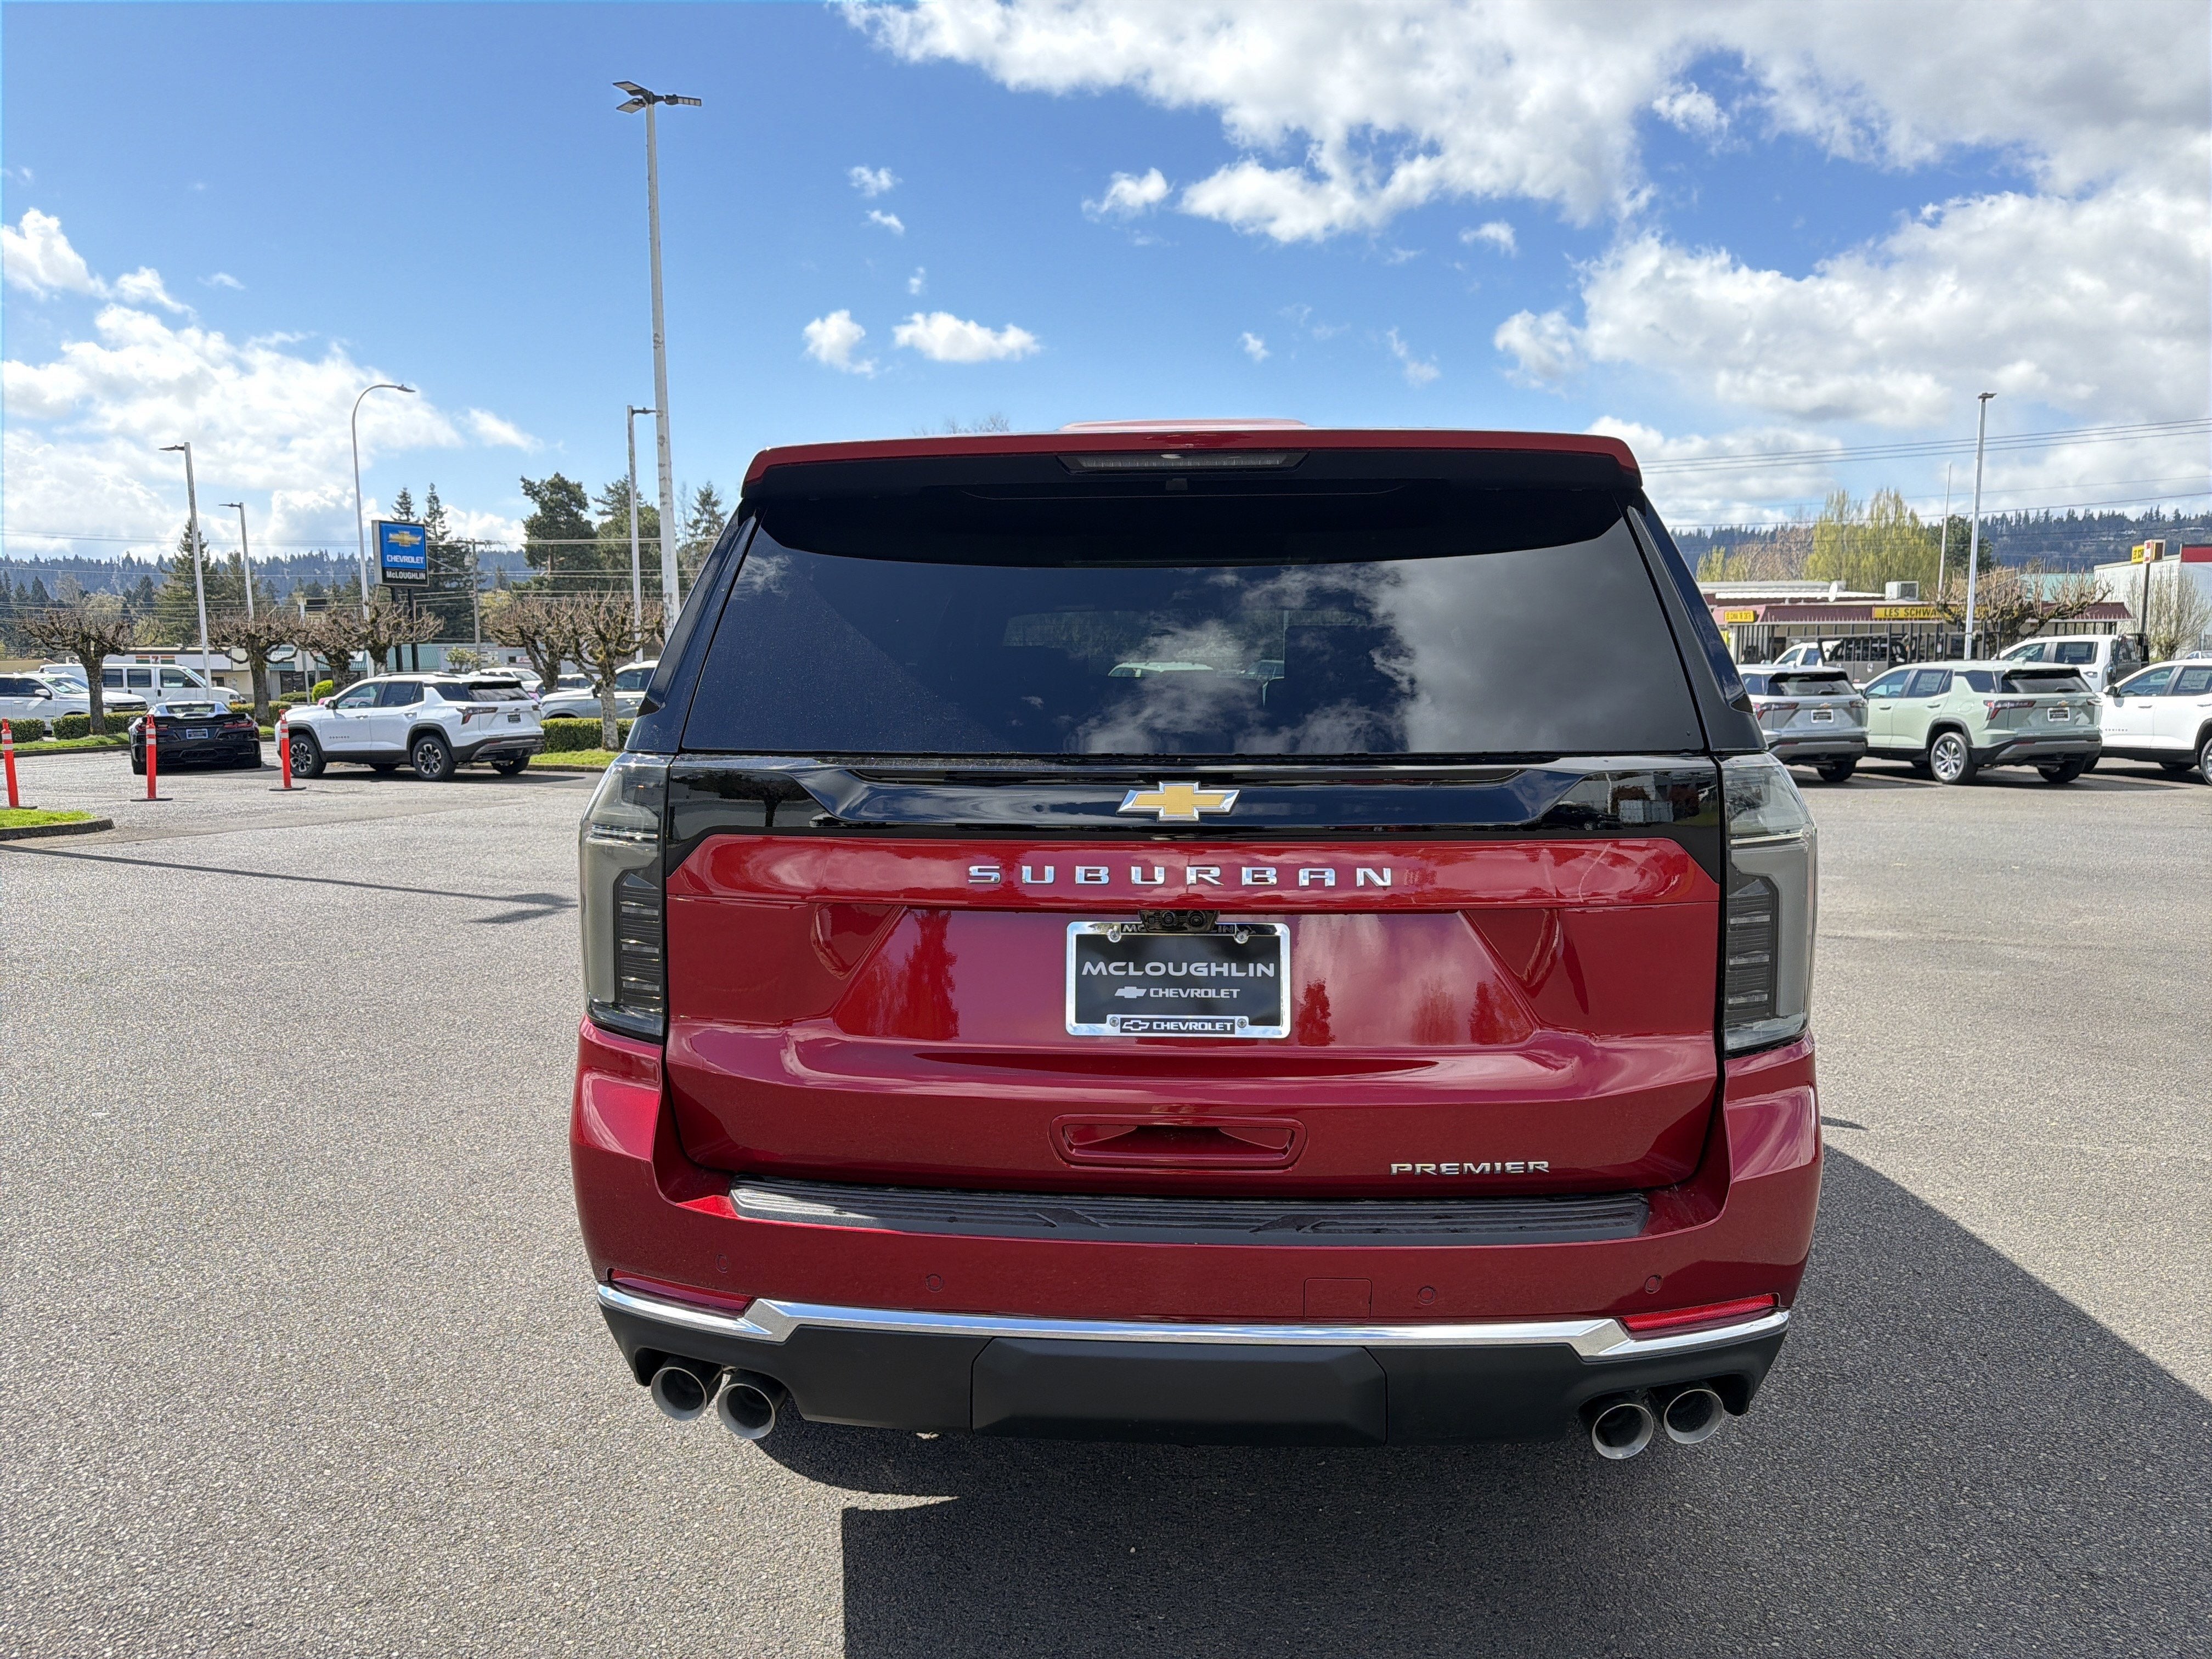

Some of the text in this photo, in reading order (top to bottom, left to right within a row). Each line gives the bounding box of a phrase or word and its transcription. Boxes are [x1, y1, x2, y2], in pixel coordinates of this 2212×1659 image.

[386, 554, 425, 564] CHEVROLET
[386, 570, 426, 580] McLOUGHLIN
[1883, 608, 1899, 617] LES
[1904, 607, 1940, 617] SCHWA
[967, 865, 1392, 887] SUBURBAN
[1081, 961, 1275, 977] MCLOUGHLIN
[1149, 988, 1241, 998] CHEVROLET
[1153, 1021, 1234, 1031] CHEVROLET
[1390, 1161, 1549, 1175] PREMIER
